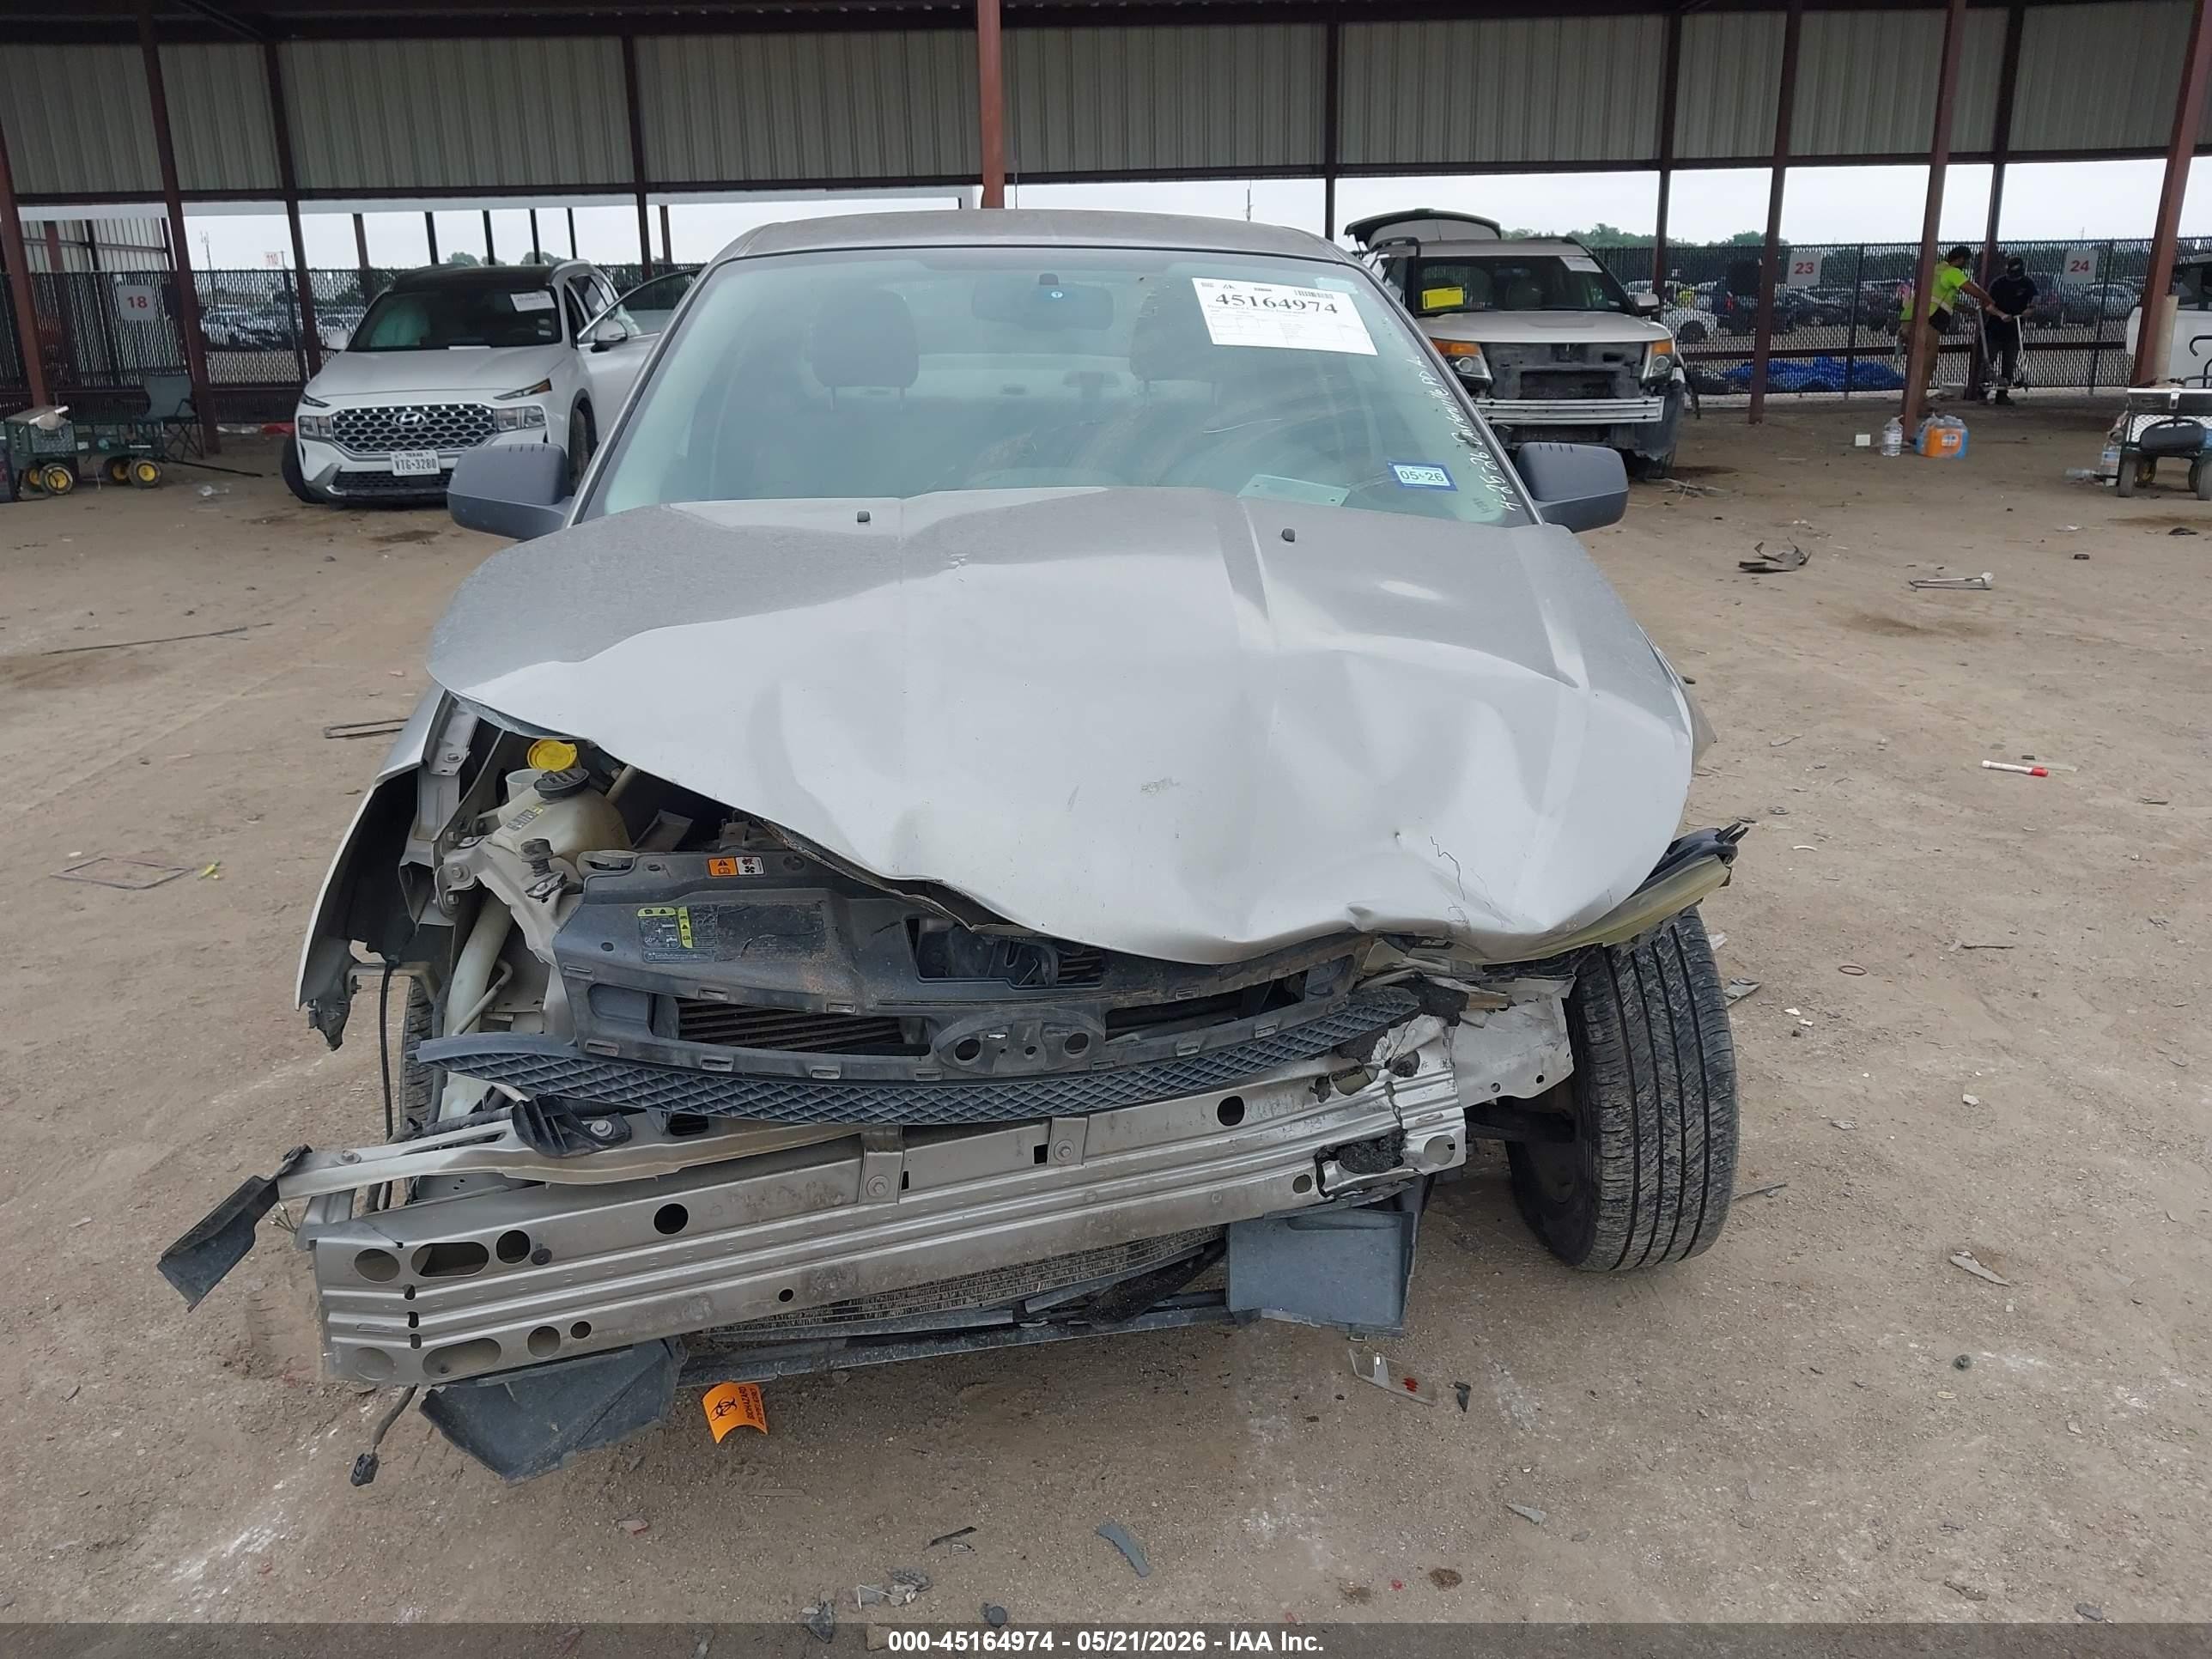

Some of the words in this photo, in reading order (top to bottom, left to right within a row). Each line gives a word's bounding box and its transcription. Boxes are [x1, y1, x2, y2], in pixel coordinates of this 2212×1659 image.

[1794, 262, 1814, 275] 23
[2069, 259, 2089, 272] 24
[127, 295, 148, 309] 18
[1215, 293, 1338, 314] 45164974
[738, 1386, 756, 1420] BIOHAZARD
